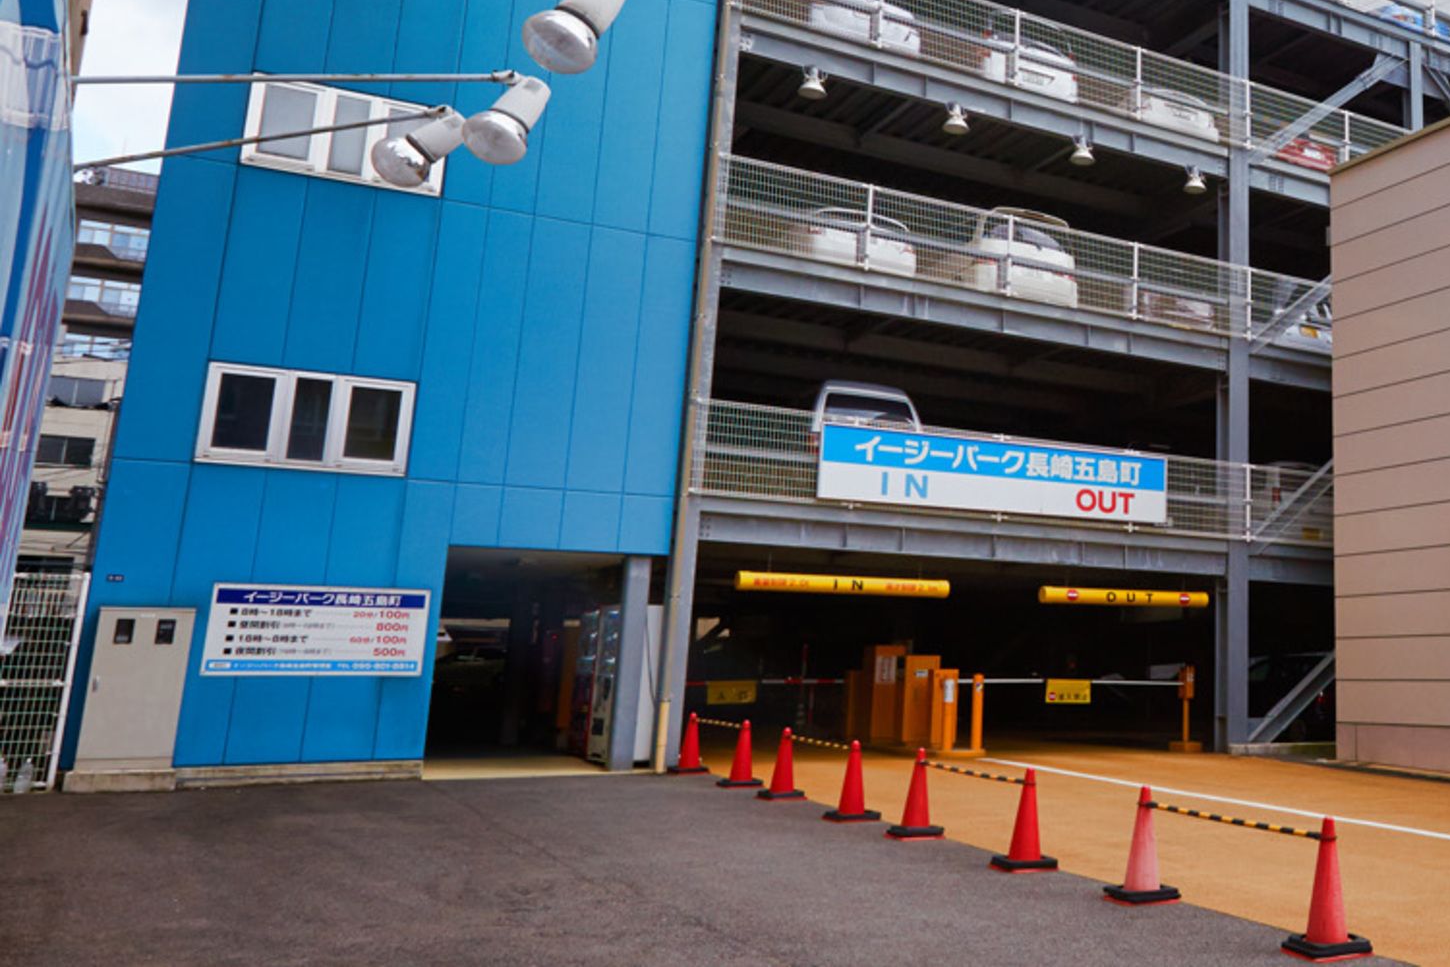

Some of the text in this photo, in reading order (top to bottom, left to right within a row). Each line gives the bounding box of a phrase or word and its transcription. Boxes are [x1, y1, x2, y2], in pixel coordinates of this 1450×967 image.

[855, 435, 1142, 487] イージーパーク長崎五島町
[881, 471, 930, 499] IN
[1075, 488, 1136, 515] OUT
[833, 578, 864, 591] IN
[243, 591, 403, 607] イージーパーク長崎五島町
[1106, 591, 1154, 603] OUT
